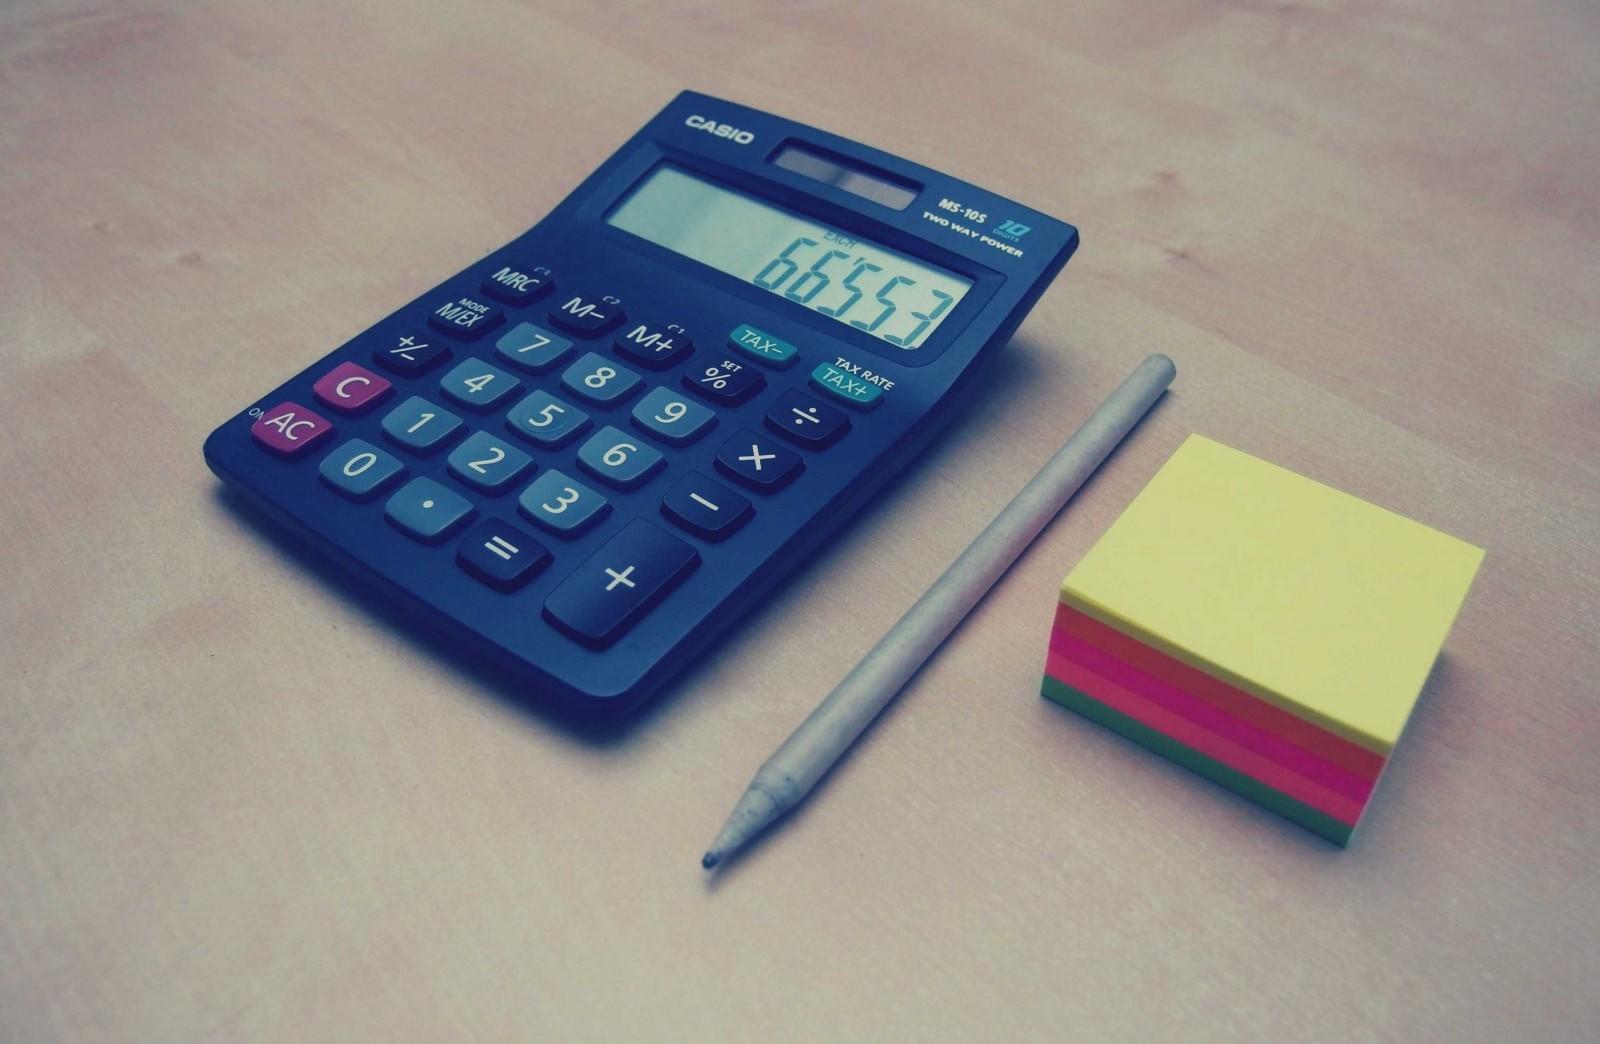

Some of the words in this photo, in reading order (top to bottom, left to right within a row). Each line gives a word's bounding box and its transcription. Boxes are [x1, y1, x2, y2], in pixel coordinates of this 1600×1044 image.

[685, 115, 754, 145] CASIO
[938, 198, 987, 224] MS-10S
[922, 211, 950, 227] TWO
[951, 223, 980, 239] WAY
[980, 235, 1024, 258] POWER
[998, 219, 1031, 237] 10
[491, 267, 540, 292] MRC
[435, 302, 484, 328] M/EX
[459, 298, 490, 314] MODE
[517, 334, 551, 352] 7
[626, 325, 673, 352] M+
[584, 367, 616, 388] 8
[701, 367, 731, 389] %
[720, 360, 742, 373] SET
[835, 357, 861, 376] TAX
[862, 370, 896, 392] RATE
[335, 376, 370, 398] C
[463, 374, 495, 393] 4
[820, 367, 867, 396] TAX+
[407, 413, 436, 433] 1
[528, 404, 565, 427] 5
[654, 402, 687, 424] 9
[264, 412, 315, 440] AC
[342, 452, 377, 477] 0
[467, 447, 505, 474] 2
[602, 443, 637, 466] 6
[541, 487, 580, 514] 3
